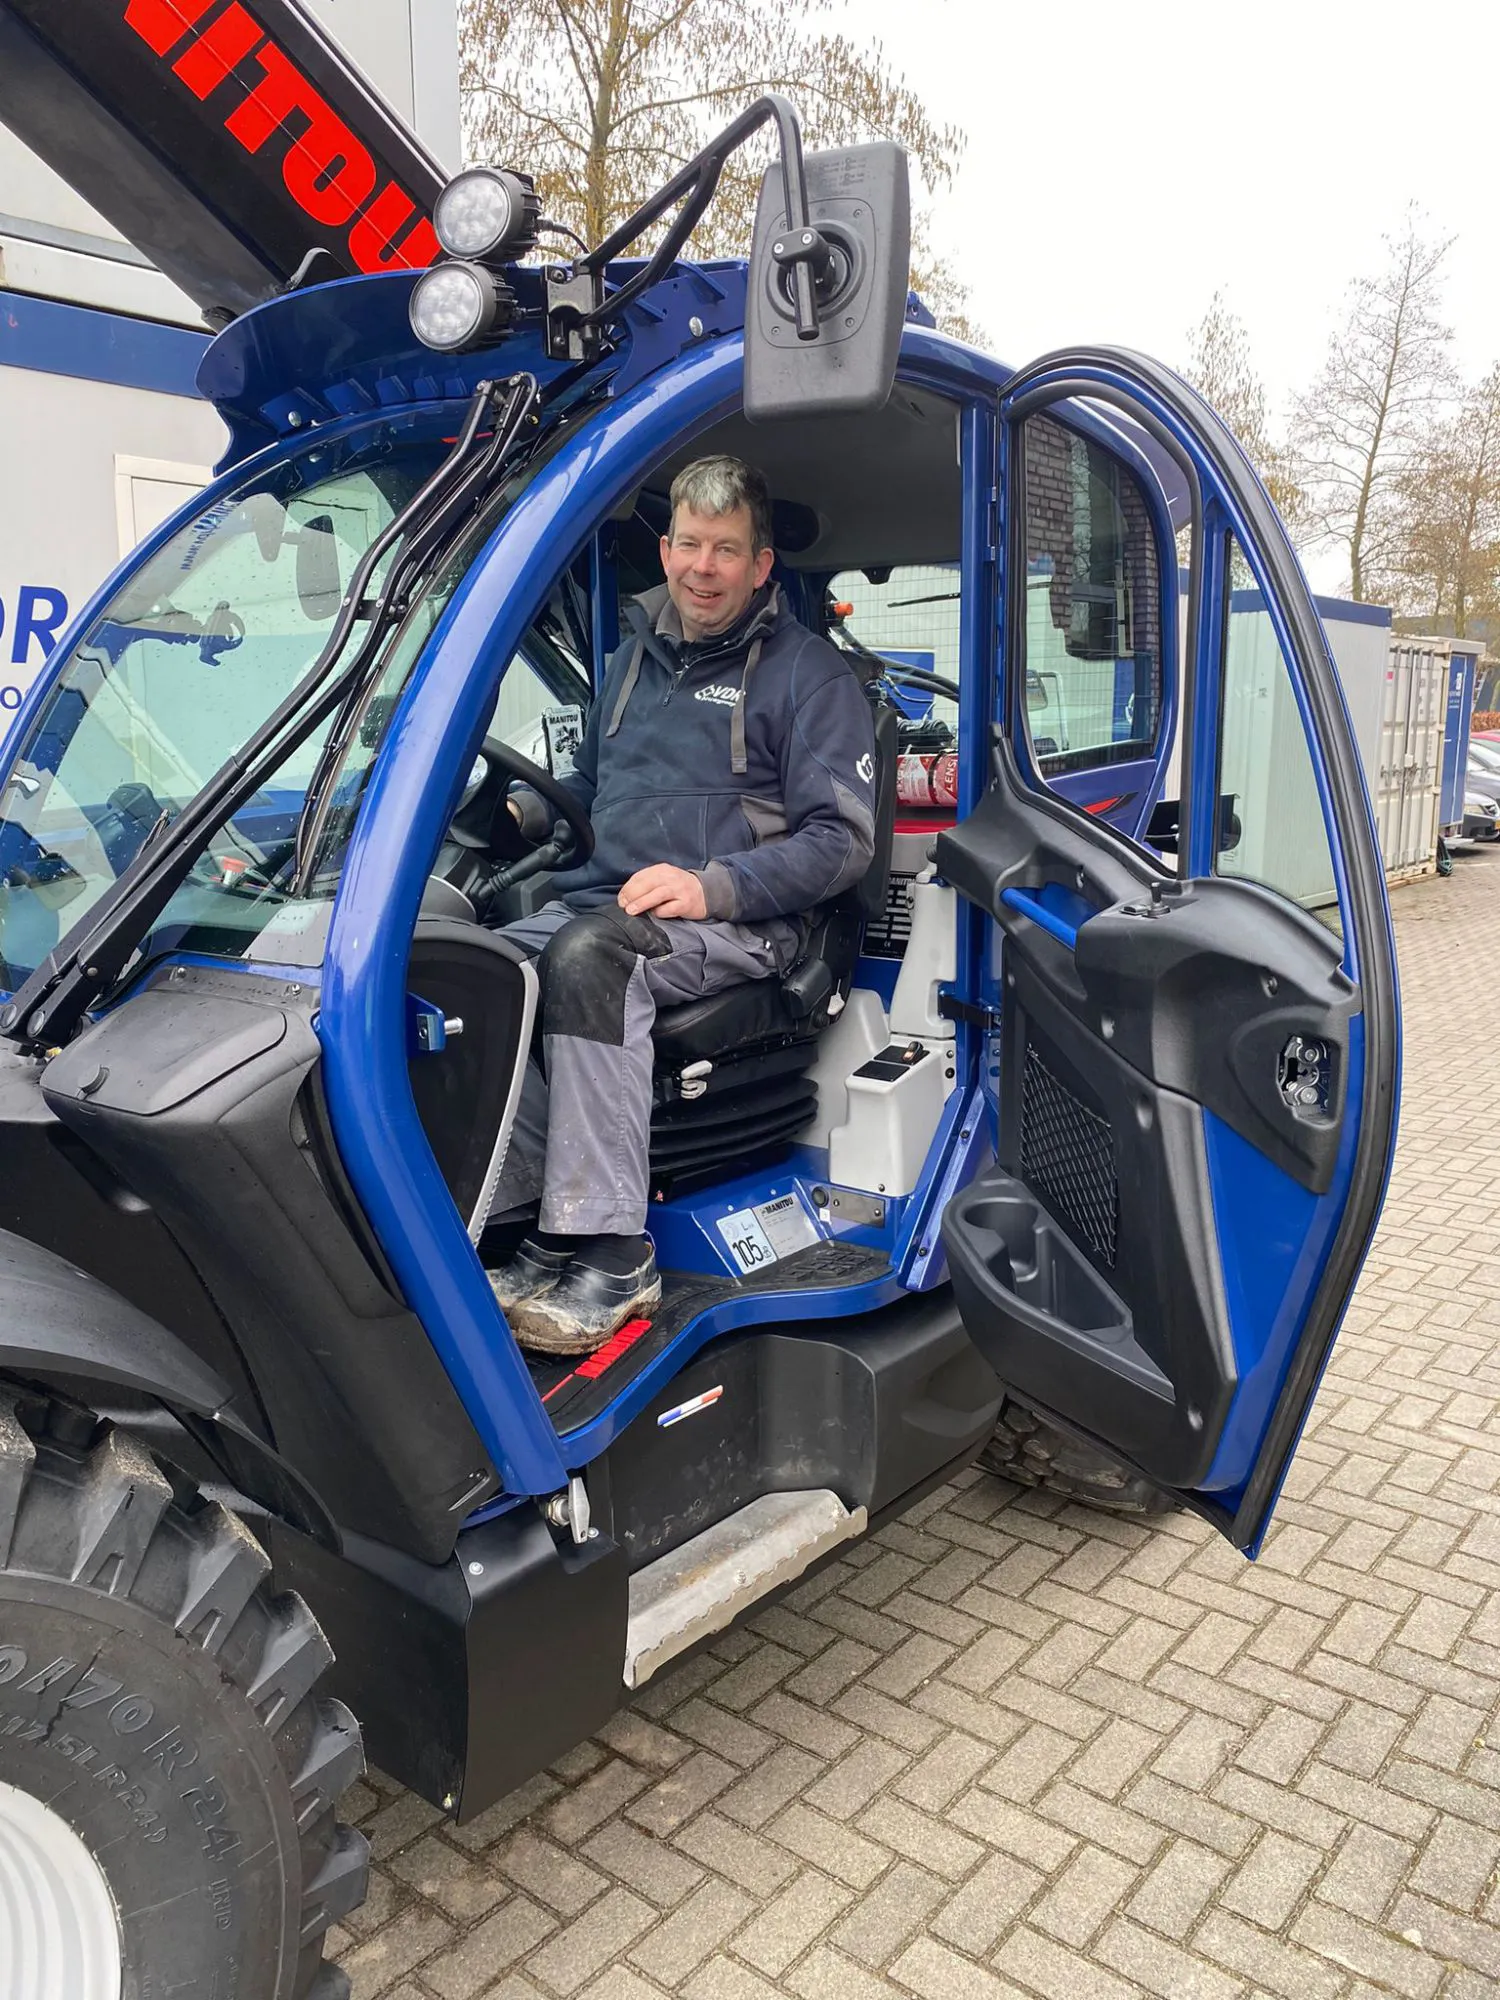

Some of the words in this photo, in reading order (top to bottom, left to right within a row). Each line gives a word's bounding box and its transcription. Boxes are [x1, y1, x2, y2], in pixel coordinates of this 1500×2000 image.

[0, 585, 68, 663] R
[549, 714, 579, 725] MANITOU
[764, 1196, 794, 1214] MANITOU
[732, 1235, 764, 1267] 105
